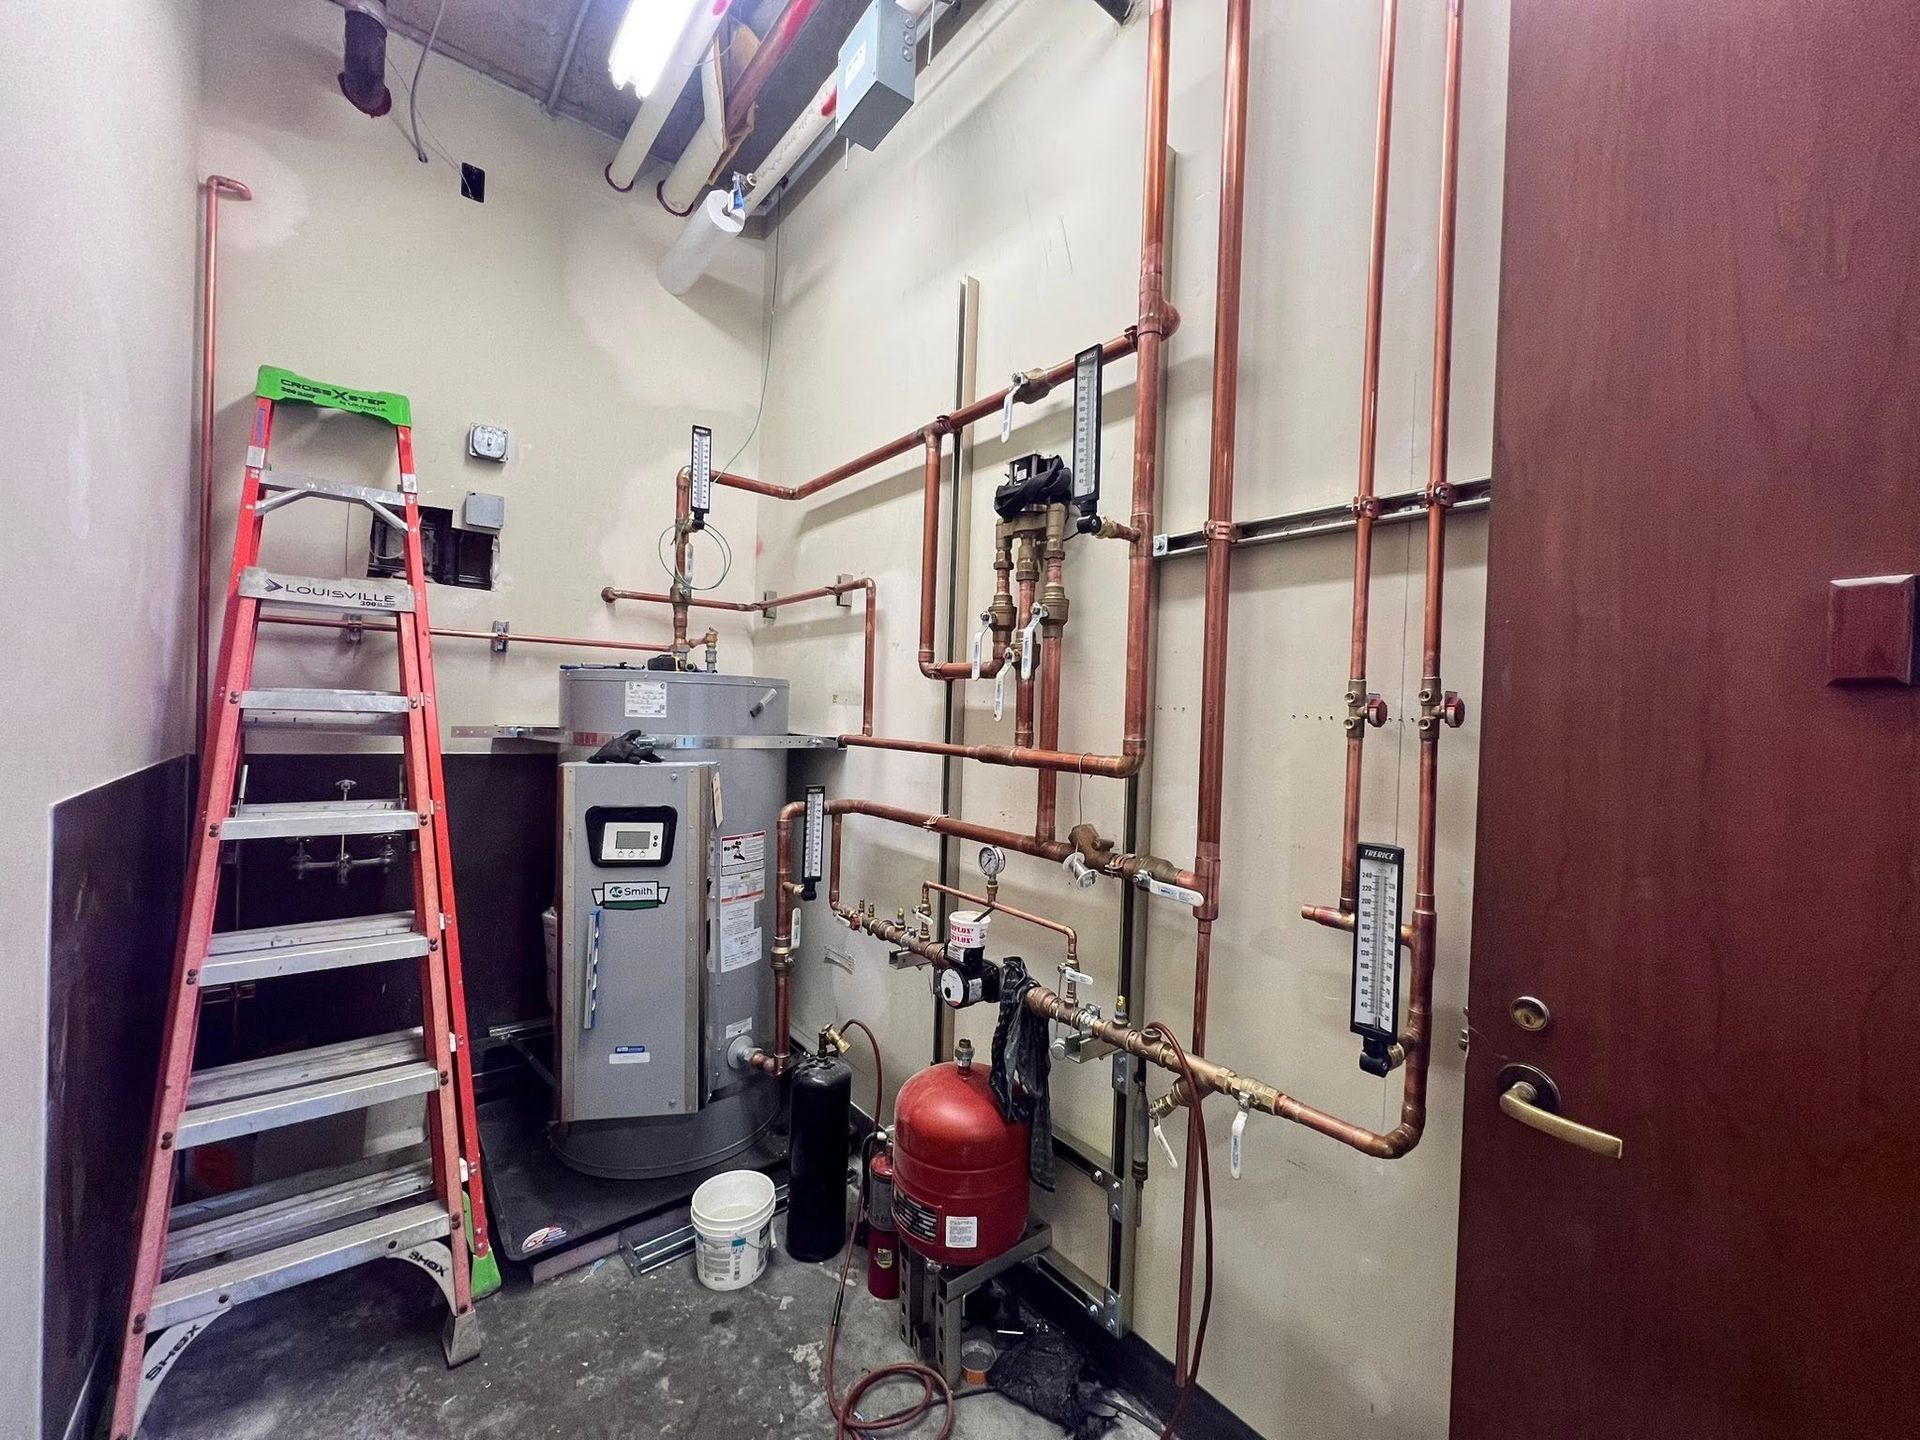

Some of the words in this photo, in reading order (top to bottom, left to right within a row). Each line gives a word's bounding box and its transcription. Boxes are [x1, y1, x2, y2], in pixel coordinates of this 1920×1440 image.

[285, 583, 396, 603] LOUISVILLE
[1364, 849, 1395, 860] TRERICE
[624, 887, 653, 896] Smith
[409, 1250, 449, 1278] SHOX
[145, 1324, 202, 1381] SHOX
